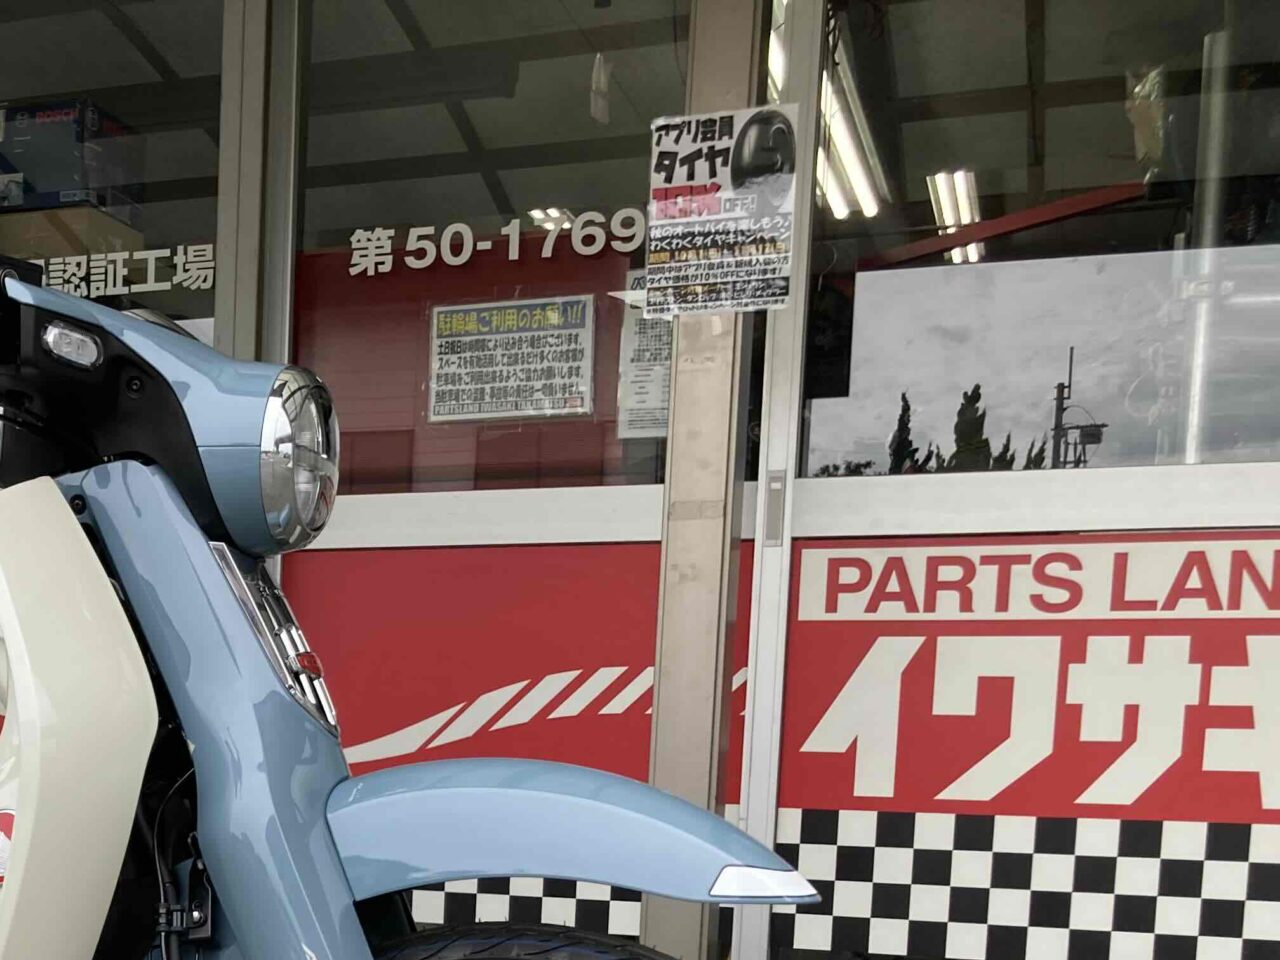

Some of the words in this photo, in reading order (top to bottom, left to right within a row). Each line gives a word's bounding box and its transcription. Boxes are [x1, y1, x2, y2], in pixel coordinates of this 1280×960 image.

[653, 145, 731, 184] タイヤ
[28, 243, 216, 298] 認証工場
[824, 552, 1084, 614] PARTS
[1109, 550, 1280, 612] LAN
